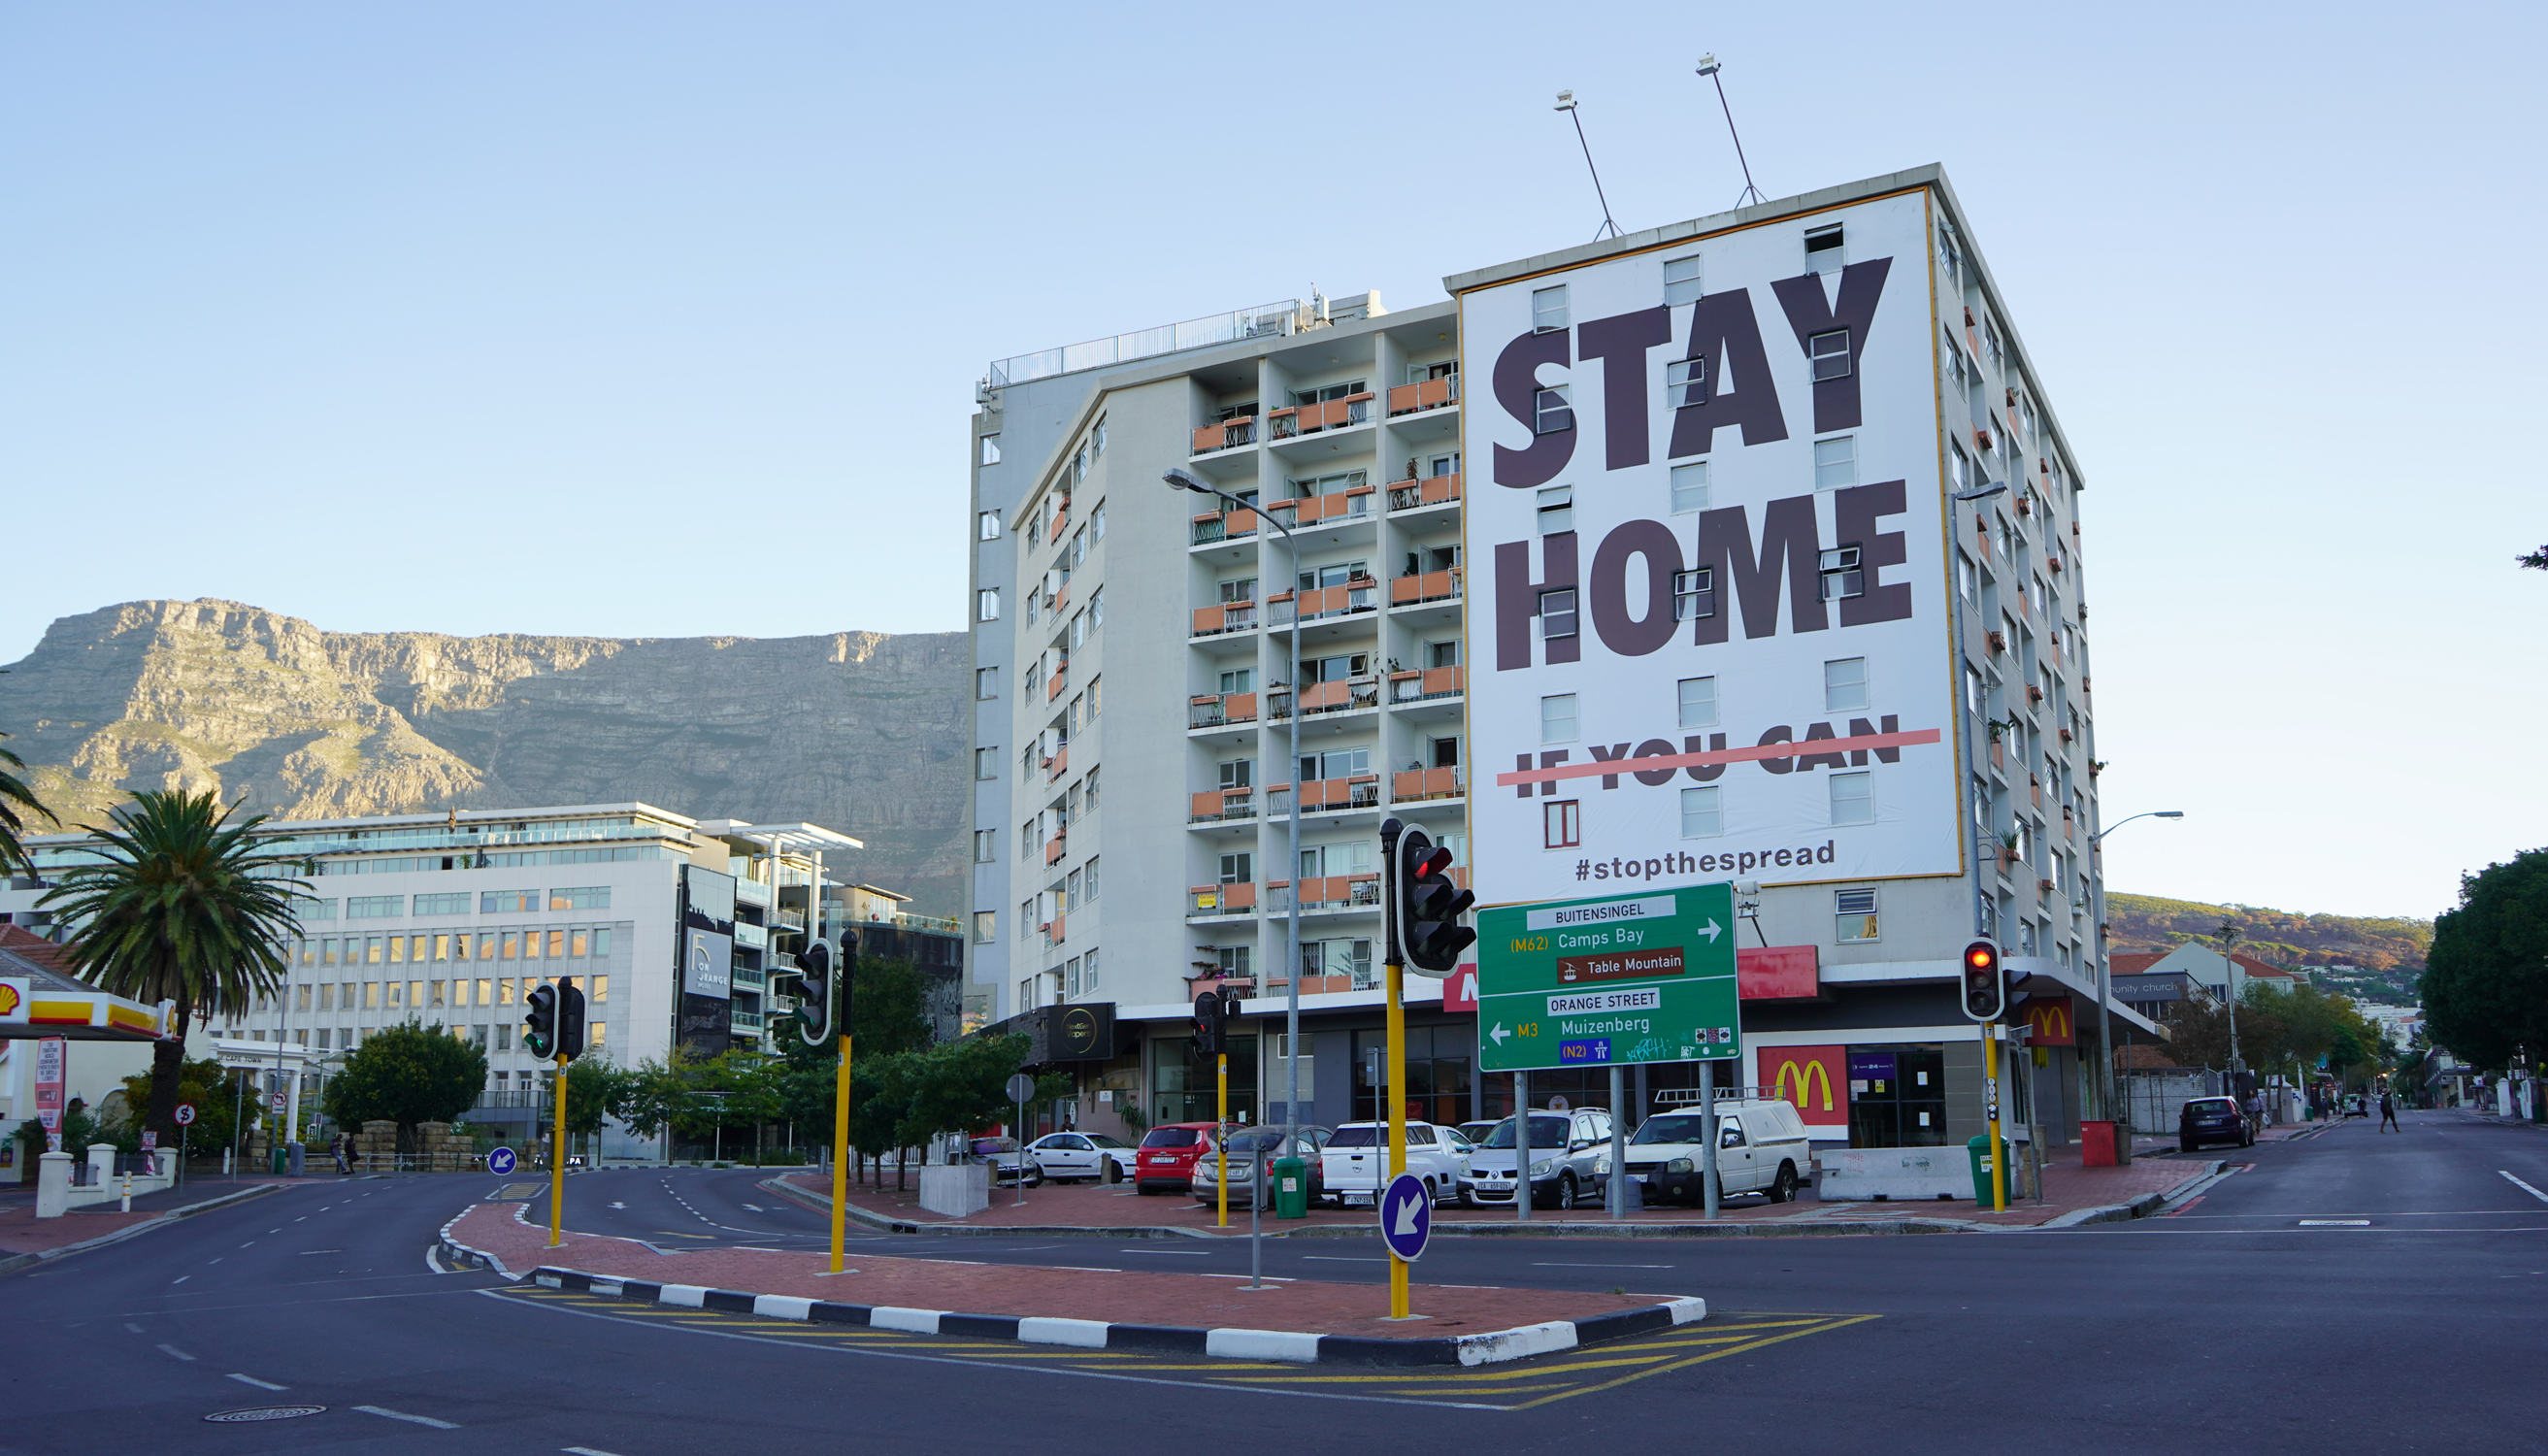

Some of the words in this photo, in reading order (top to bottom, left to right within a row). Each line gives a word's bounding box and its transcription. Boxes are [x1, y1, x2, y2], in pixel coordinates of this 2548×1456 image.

[1493, 256, 1893, 488] STAY
[1495, 480, 1912, 671] HOME
[1516, 749, 1569, 798] IF
[1588, 733, 1726, 789] YOU
[1757, 714, 1901, 775] CAN
[1575, 840, 1835, 880] #stopthespread
[1556, 904, 1644, 923] BUITENSINGEL
[1510, 936, 1549, 953] (M62)
[1558, 933, 1609, 949] Camps
[1616, 928, 1644, 945] Bay
[1588, 961, 1620, 975] Table
[1625, 955, 1682, 971] Mountain
[2142, 982, 2178, 992] church
[1551, 997, 1602, 1011] ORANGE
[1608, 992, 1656, 1008] STREET
[1066, 1030, 1091, 1040] Vapers
[1518, 1023, 1539, 1038] M3
[1562, 1017, 1650, 1035] Muizenberg
[1563, 1044, 1587, 1059] (N2)
